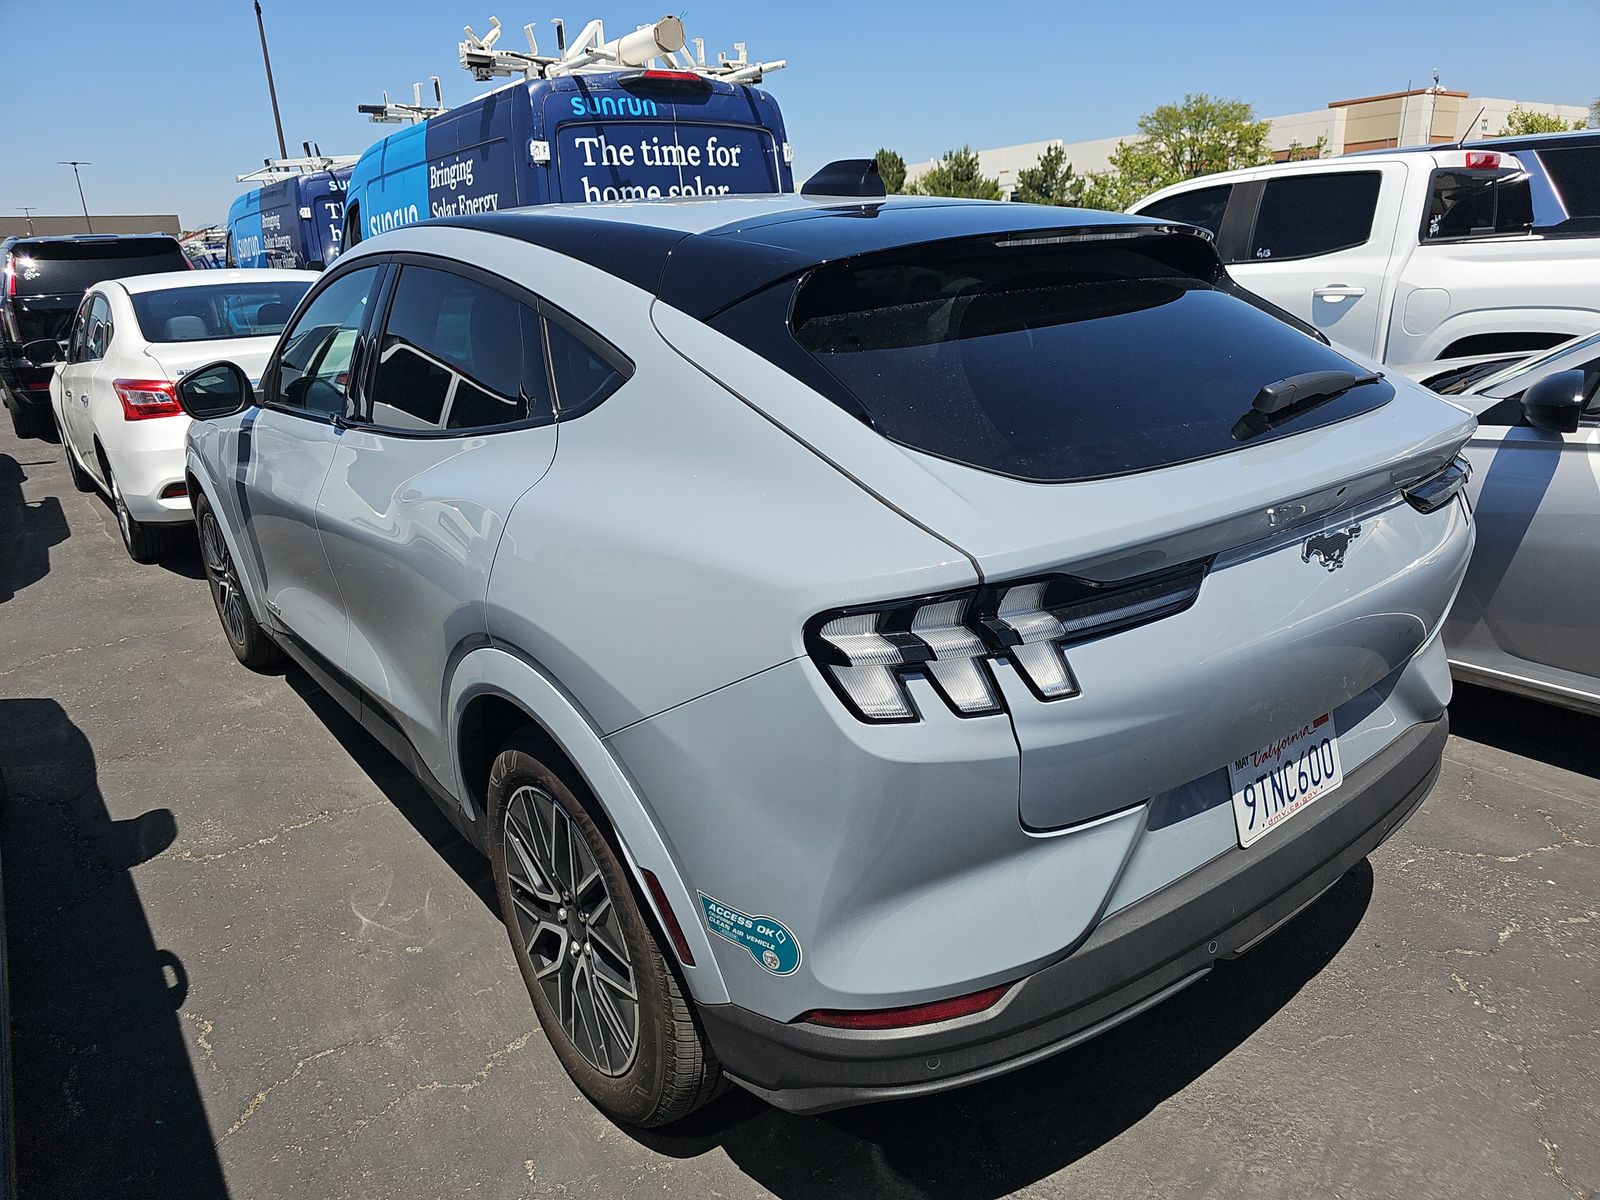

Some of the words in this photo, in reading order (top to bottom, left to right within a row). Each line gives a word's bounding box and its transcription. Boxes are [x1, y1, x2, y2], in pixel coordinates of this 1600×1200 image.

[571, 96, 657, 117] sunrun
[575, 135, 634, 166] The
[640, 136, 701, 167] time
[705, 136, 742, 167] for
[429, 156, 474, 190] Bringing
[432, 197, 457, 218] Solar
[458, 193, 499, 216] Energy
[580, 176, 661, 203] home
[262, 211, 281, 231] Bringing
[370, 204, 419, 236] sunrun
[238, 235, 261, 259] sunrun
[263, 234, 275, 249] Solar
[274, 233, 292, 251] Energy
[1251, 724, 1316, 768] California
[1235, 753, 1250, 772] MAY
[1243, 737, 1334, 830] 9TNC600
[1268, 789, 1318, 827] dmv.ca.gov
[708, 903, 753, 929] ACCESS
[756, 924, 775, 938] OK
[708, 916, 730, 930] CLEAN
[732, 928, 744, 937] AIR
[746, 934, 776, 951] VEHICLE
